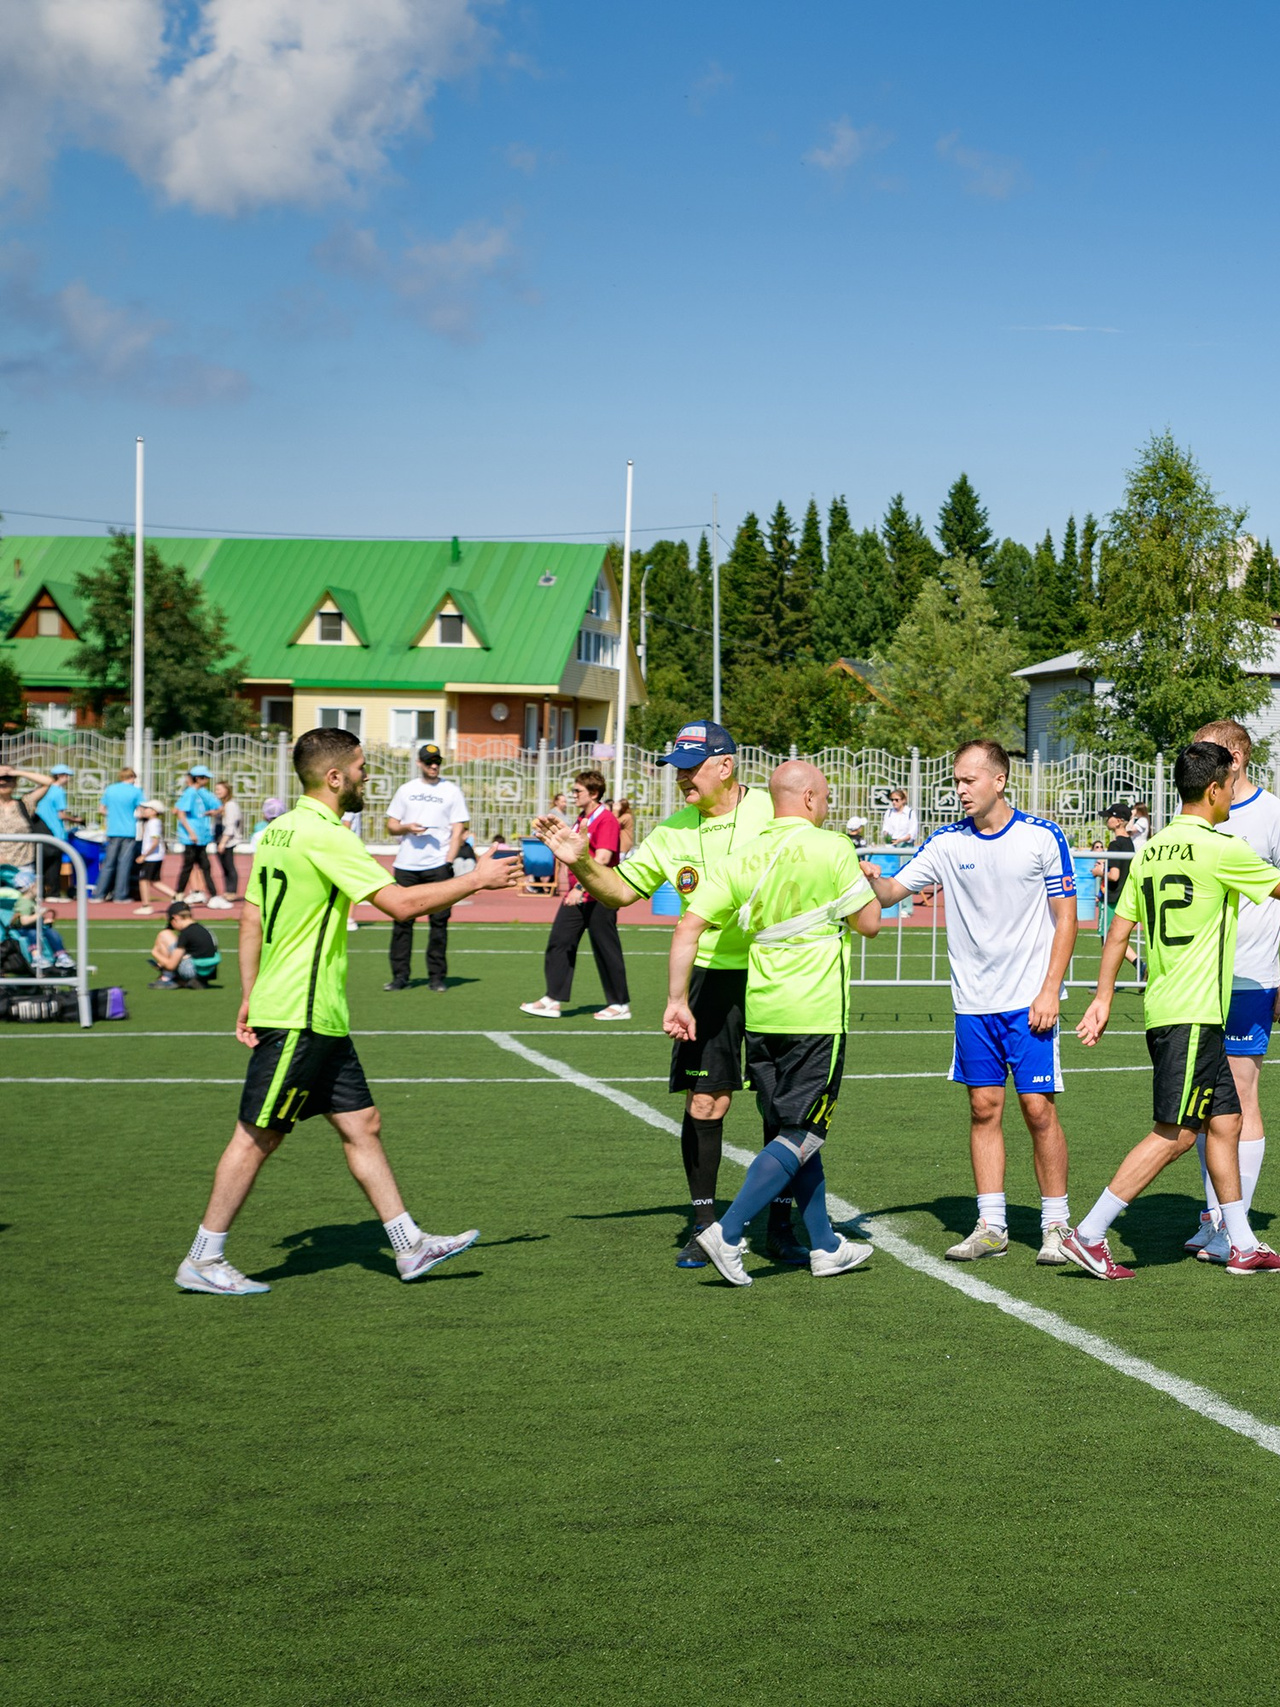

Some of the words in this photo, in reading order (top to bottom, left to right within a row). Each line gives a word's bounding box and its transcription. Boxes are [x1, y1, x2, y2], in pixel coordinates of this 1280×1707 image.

[409, 793, 443, 803] adidas
[1140, 843, 1195, 866] ЮГРА
[259, 866, 288, 944] 17
[1140, 874, 1195, 950] 12
[1186, 1086, 1213, 1119] 12
